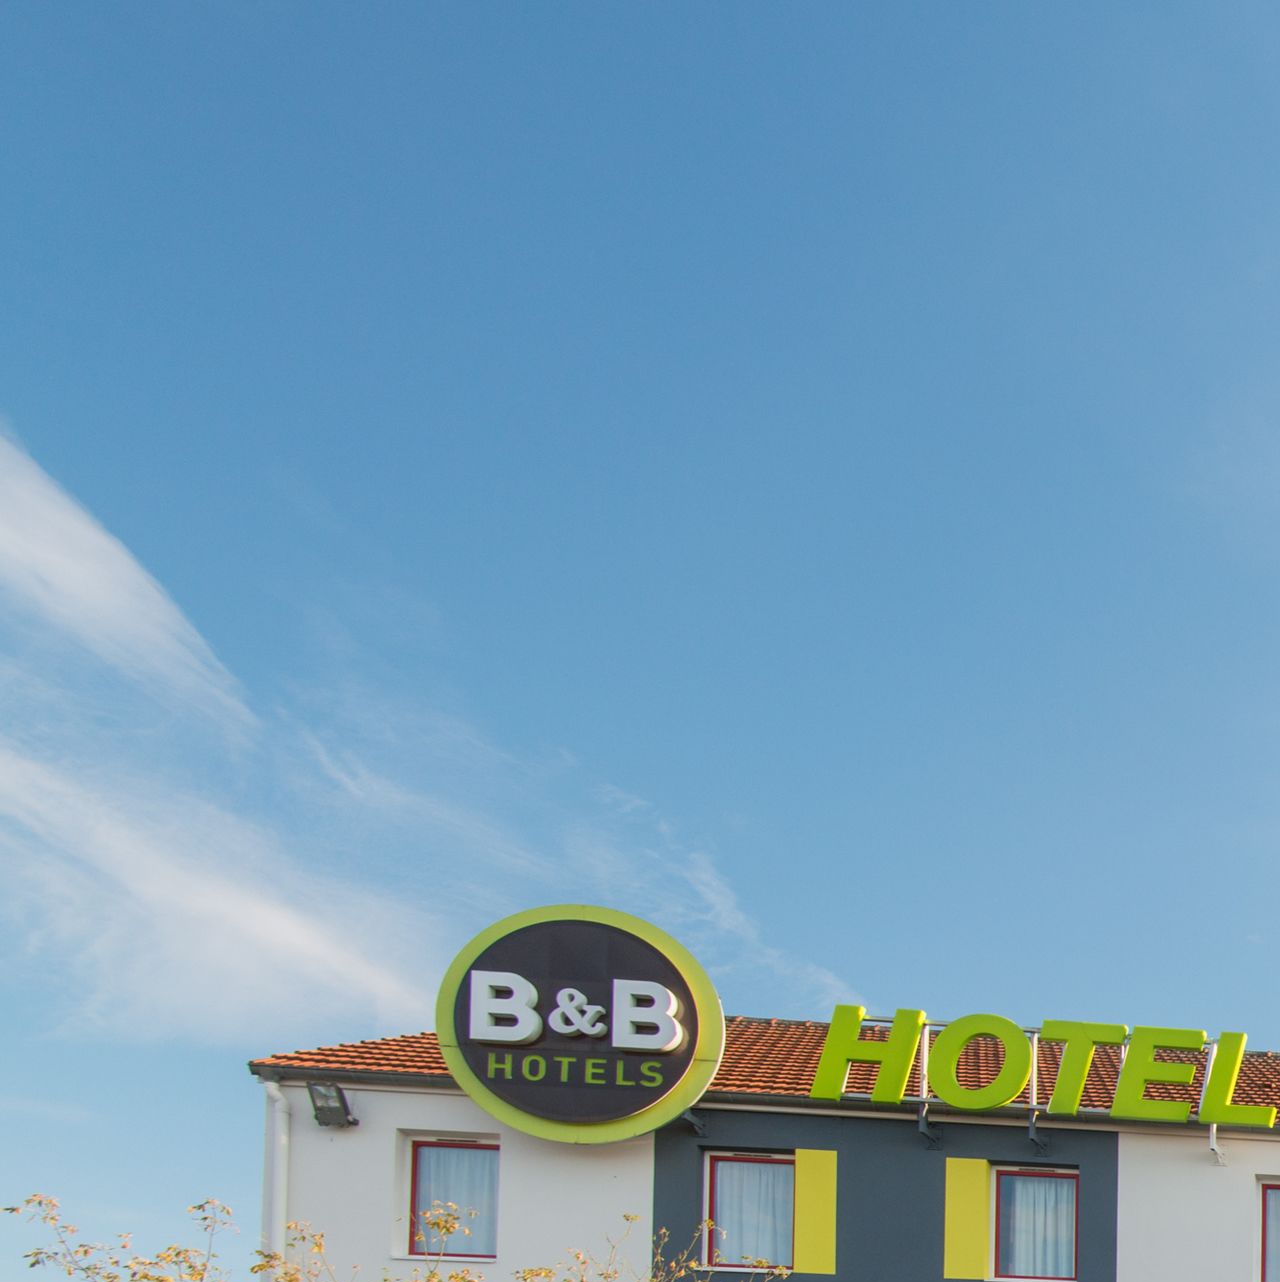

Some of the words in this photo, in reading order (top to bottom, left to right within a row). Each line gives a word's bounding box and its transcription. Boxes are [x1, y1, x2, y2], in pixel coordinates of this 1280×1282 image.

[468, 969, 685, 1053] B&B
[486, 1052, 665, 1088] HOTELS
[809, 1003, 1279, 1129] HOTEL
